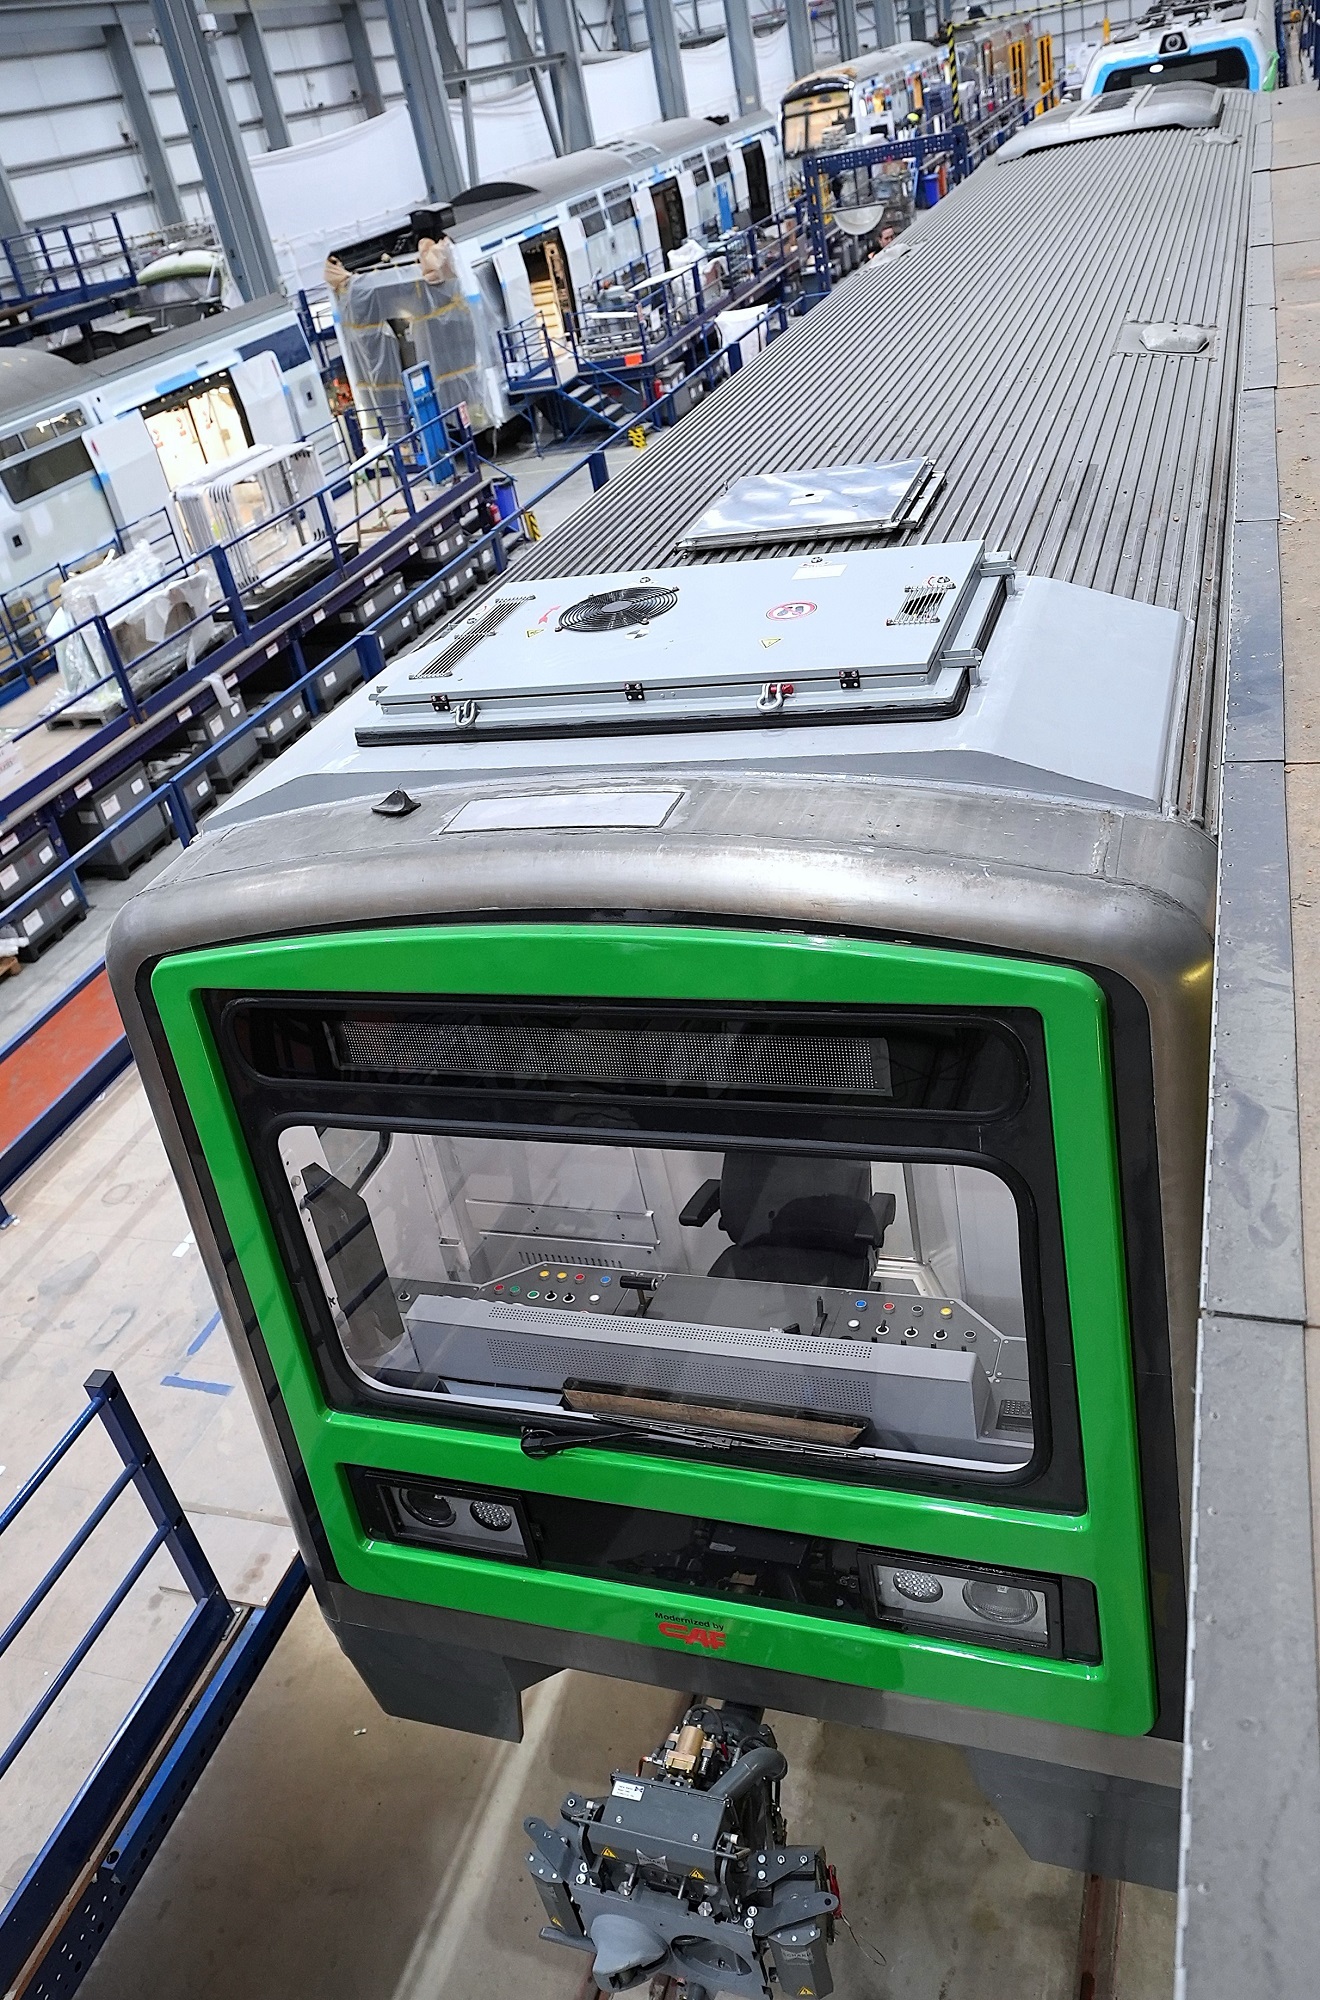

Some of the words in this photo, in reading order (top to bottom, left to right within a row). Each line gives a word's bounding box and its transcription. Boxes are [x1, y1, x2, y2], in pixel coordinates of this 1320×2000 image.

[654, 1612, 710, 1628] Modernized
[712, 1622, 724, 1631] by
[658, 1621, 726, 1650] CAF
